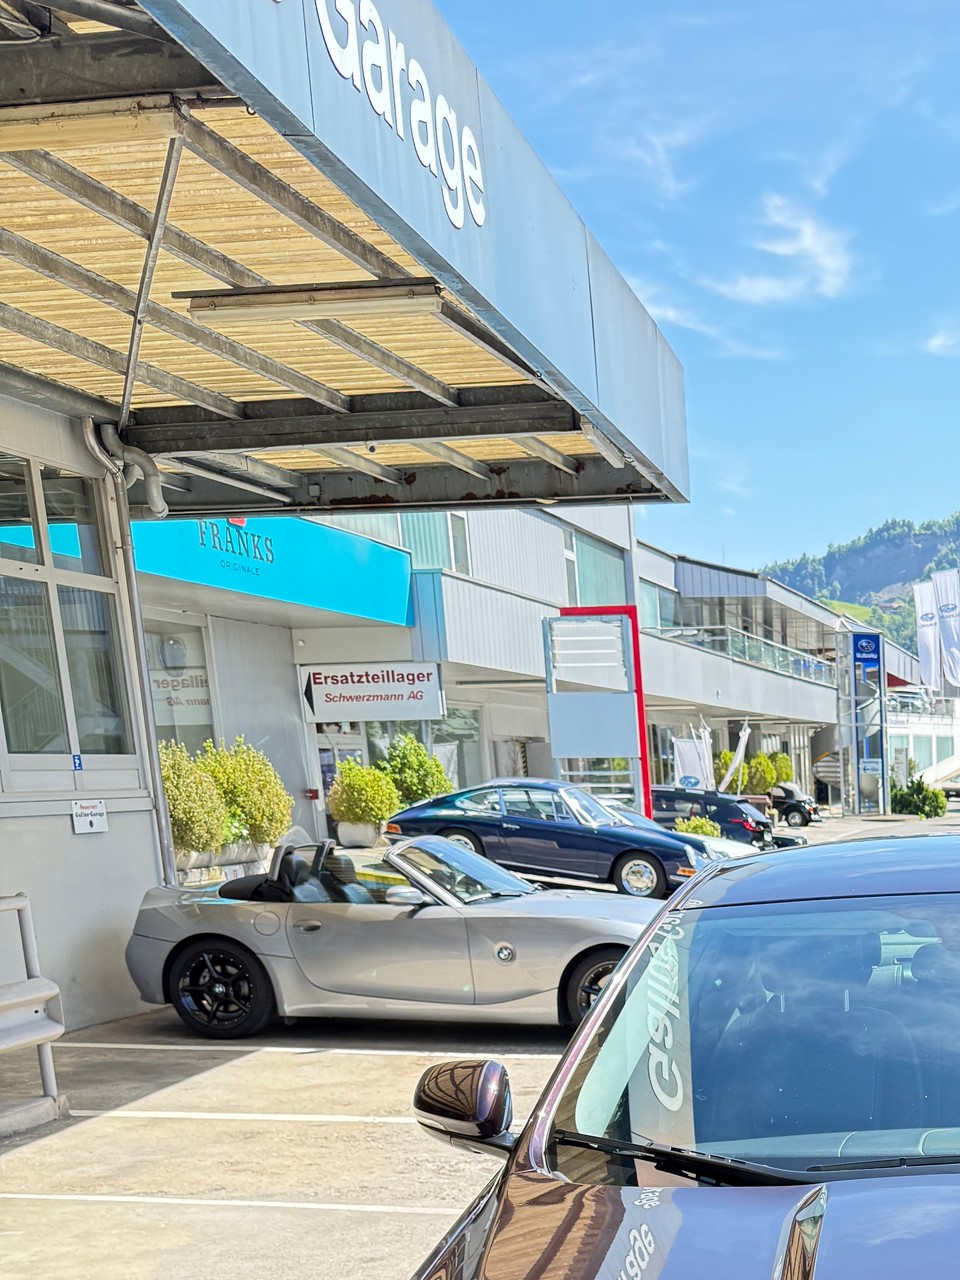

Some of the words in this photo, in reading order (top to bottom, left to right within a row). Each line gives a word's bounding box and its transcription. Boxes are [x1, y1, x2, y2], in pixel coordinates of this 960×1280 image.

[315, 0, 486, 229] Garage
[197, 518, 275, 564] FRANKS
[312, 670, 433, 686] Ersatzteillager
[324, 692, 404, 703] Schwerzmann
[407, 691, 424, 701] AG
